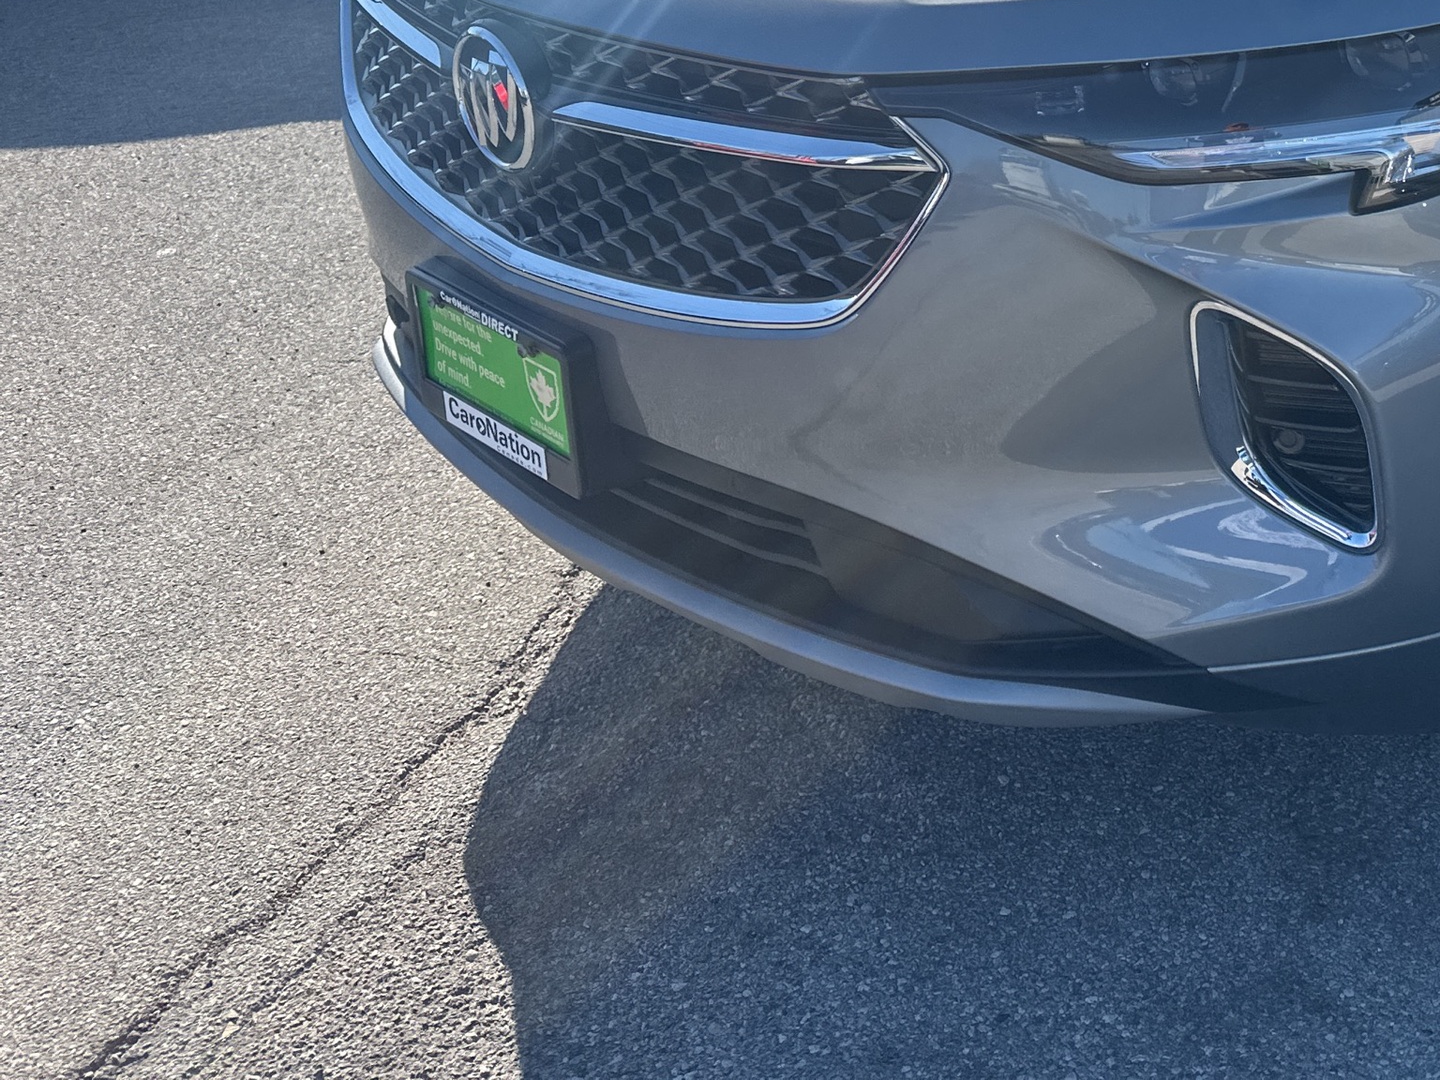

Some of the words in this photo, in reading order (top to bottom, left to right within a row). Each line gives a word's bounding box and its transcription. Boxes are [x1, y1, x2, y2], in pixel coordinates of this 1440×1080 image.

[433, 319, 484, 357] unexpected.
[476, 323, 493, 343] the
[481, 312, 519, 342] DIRECT
[435, 337, 457, 361] Drive
[458, 353, 478, 372] with
[479, 365, 506, 389] peace
[437, 360, 446, 374] of
[447, 366, 473, 389] mind.
